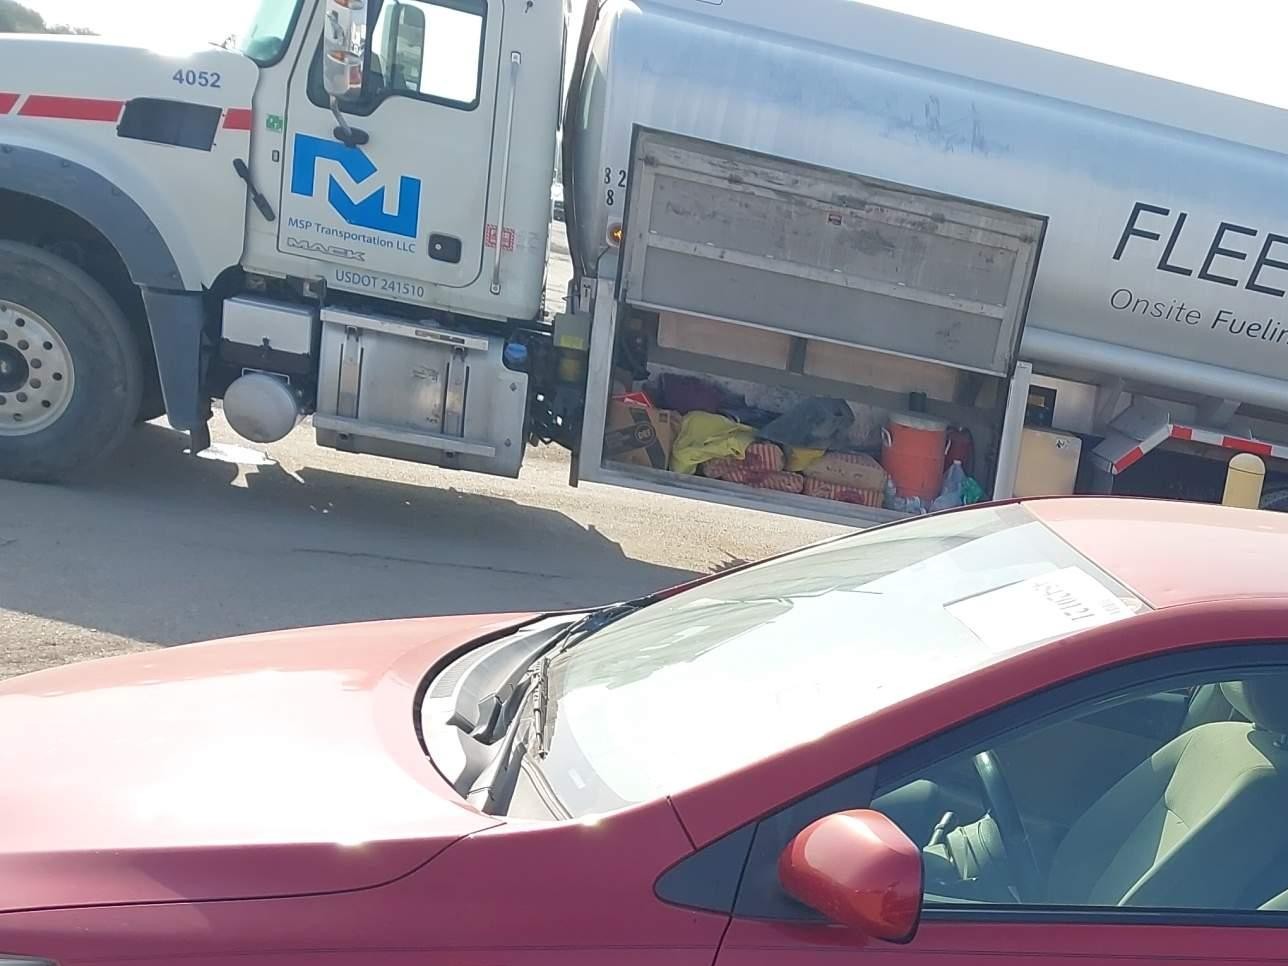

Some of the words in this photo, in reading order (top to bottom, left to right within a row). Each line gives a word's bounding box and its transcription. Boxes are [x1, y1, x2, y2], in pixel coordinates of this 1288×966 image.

[172, 69, 221, 88] 4052
[618, 170, 627, 187] 2
[606, 189, 614, 206] 8
[288, 217, 312, 230] MSP
[314, 222, 393, 249] Transportation
[396, 242, 416, 253] LLC
[287, 237, 366, 262] MACK
[335, 269, 376, 288] USDOT
[381, 278, 425, 298] 241510
[1110, 287, 1202, 327] Onsite
